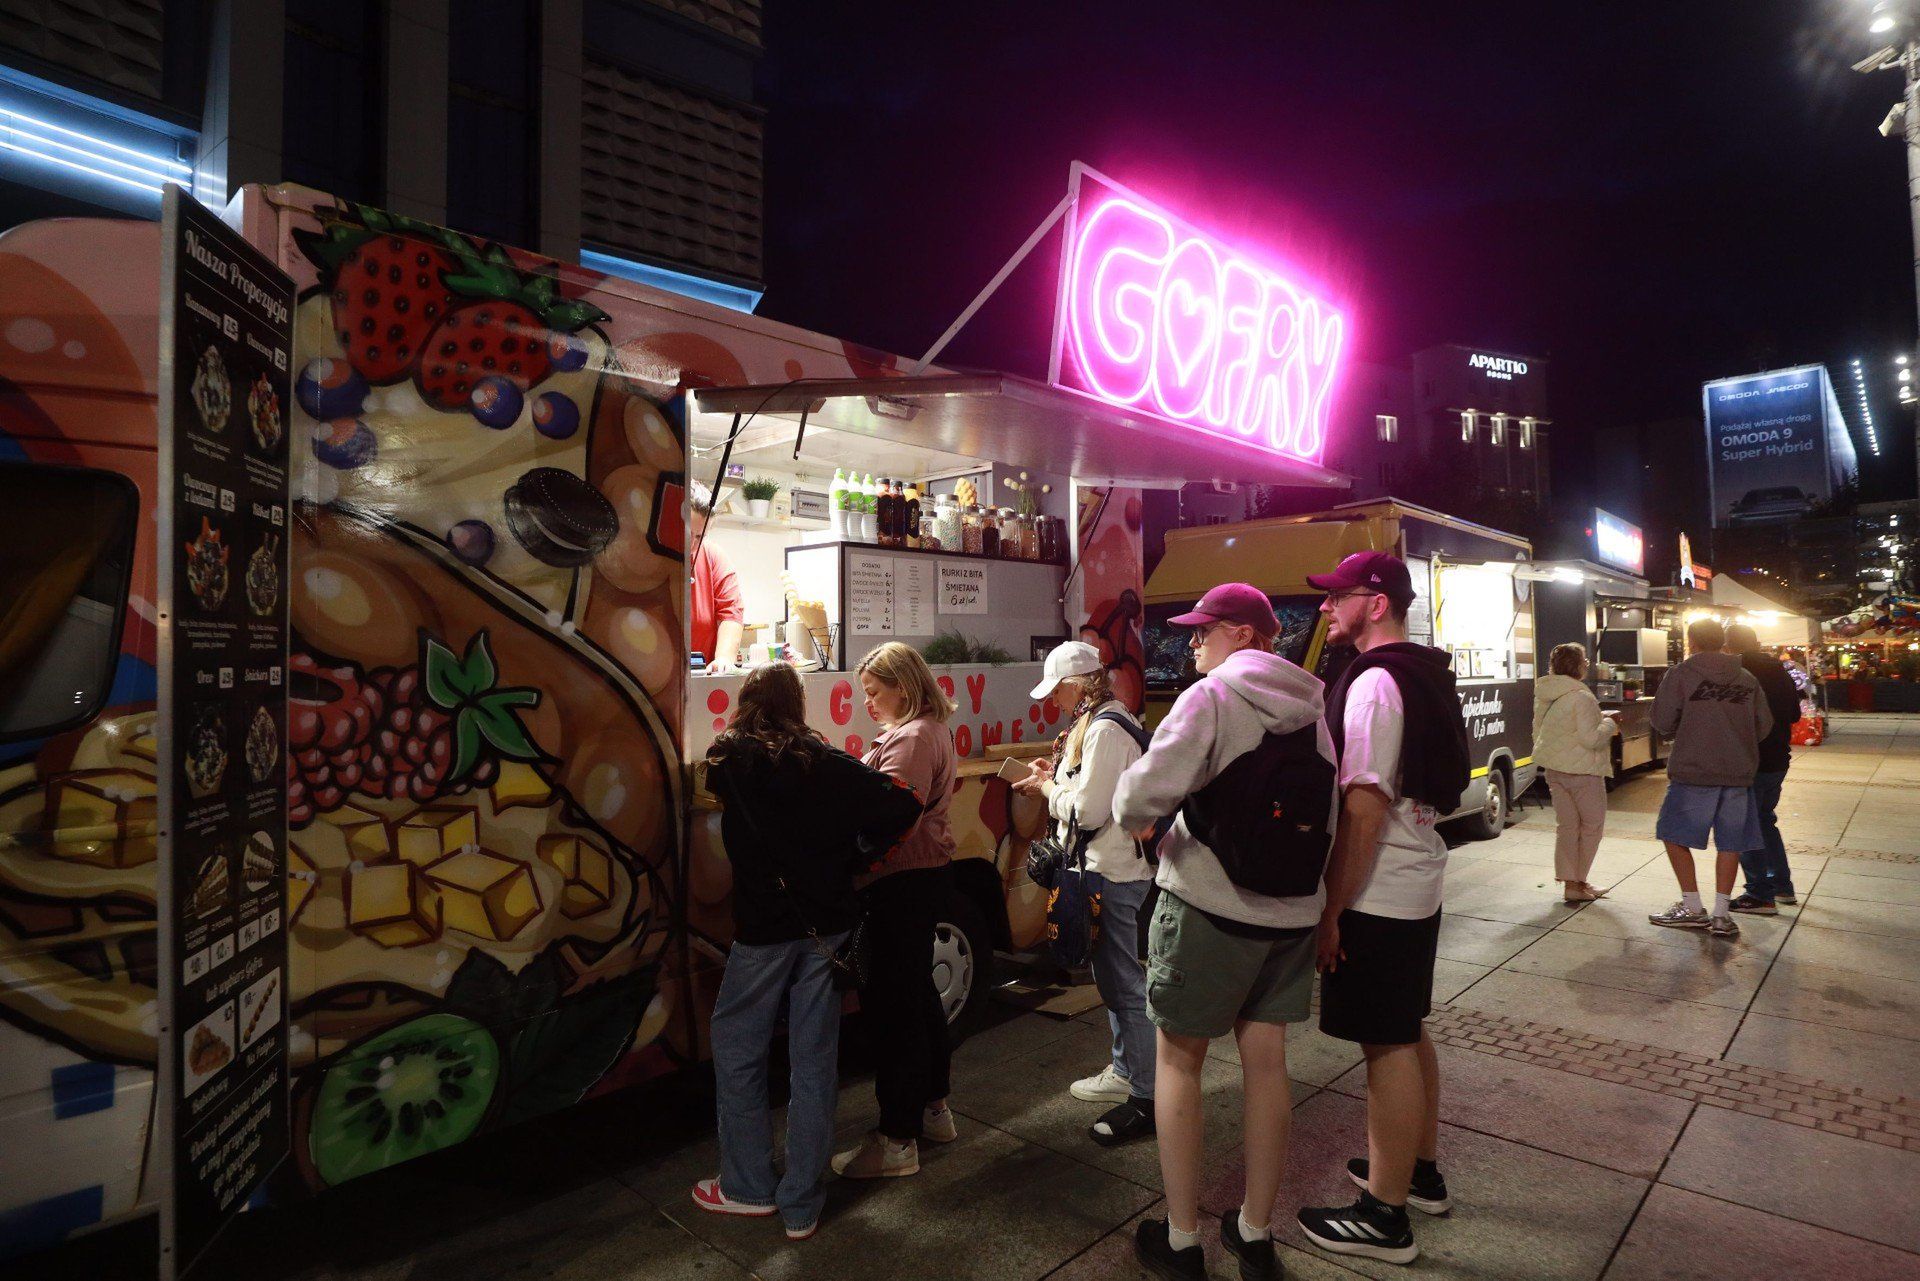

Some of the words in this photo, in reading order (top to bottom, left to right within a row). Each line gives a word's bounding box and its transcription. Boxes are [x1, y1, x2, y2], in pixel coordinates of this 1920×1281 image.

[184, 229, 227, 280] Nasza
[229, 262, 288, 324] Propozycja
[1070, 198, 1343, 458] GOFRY
[1468, 353, 1528, 375] APARTIO
[1719, 390, 1760, 401] OMODA
[1721, 430, 1780, 447] OMODA
[1782, 428, 1793, 439] 9
[1722, 448, 1762, 461] Super
[1766, 438, 1813, 456] Hybrid
[941, 568, 963, 578] RURKI
[963, 569, 968, 578] Z
[969, 570, 983, 580] BITĄ
[945, 581, 980, 594] ŚMIETANĄ
[951, 594, 958, 606] 6
[244, 668, 268, 682] Snickers
